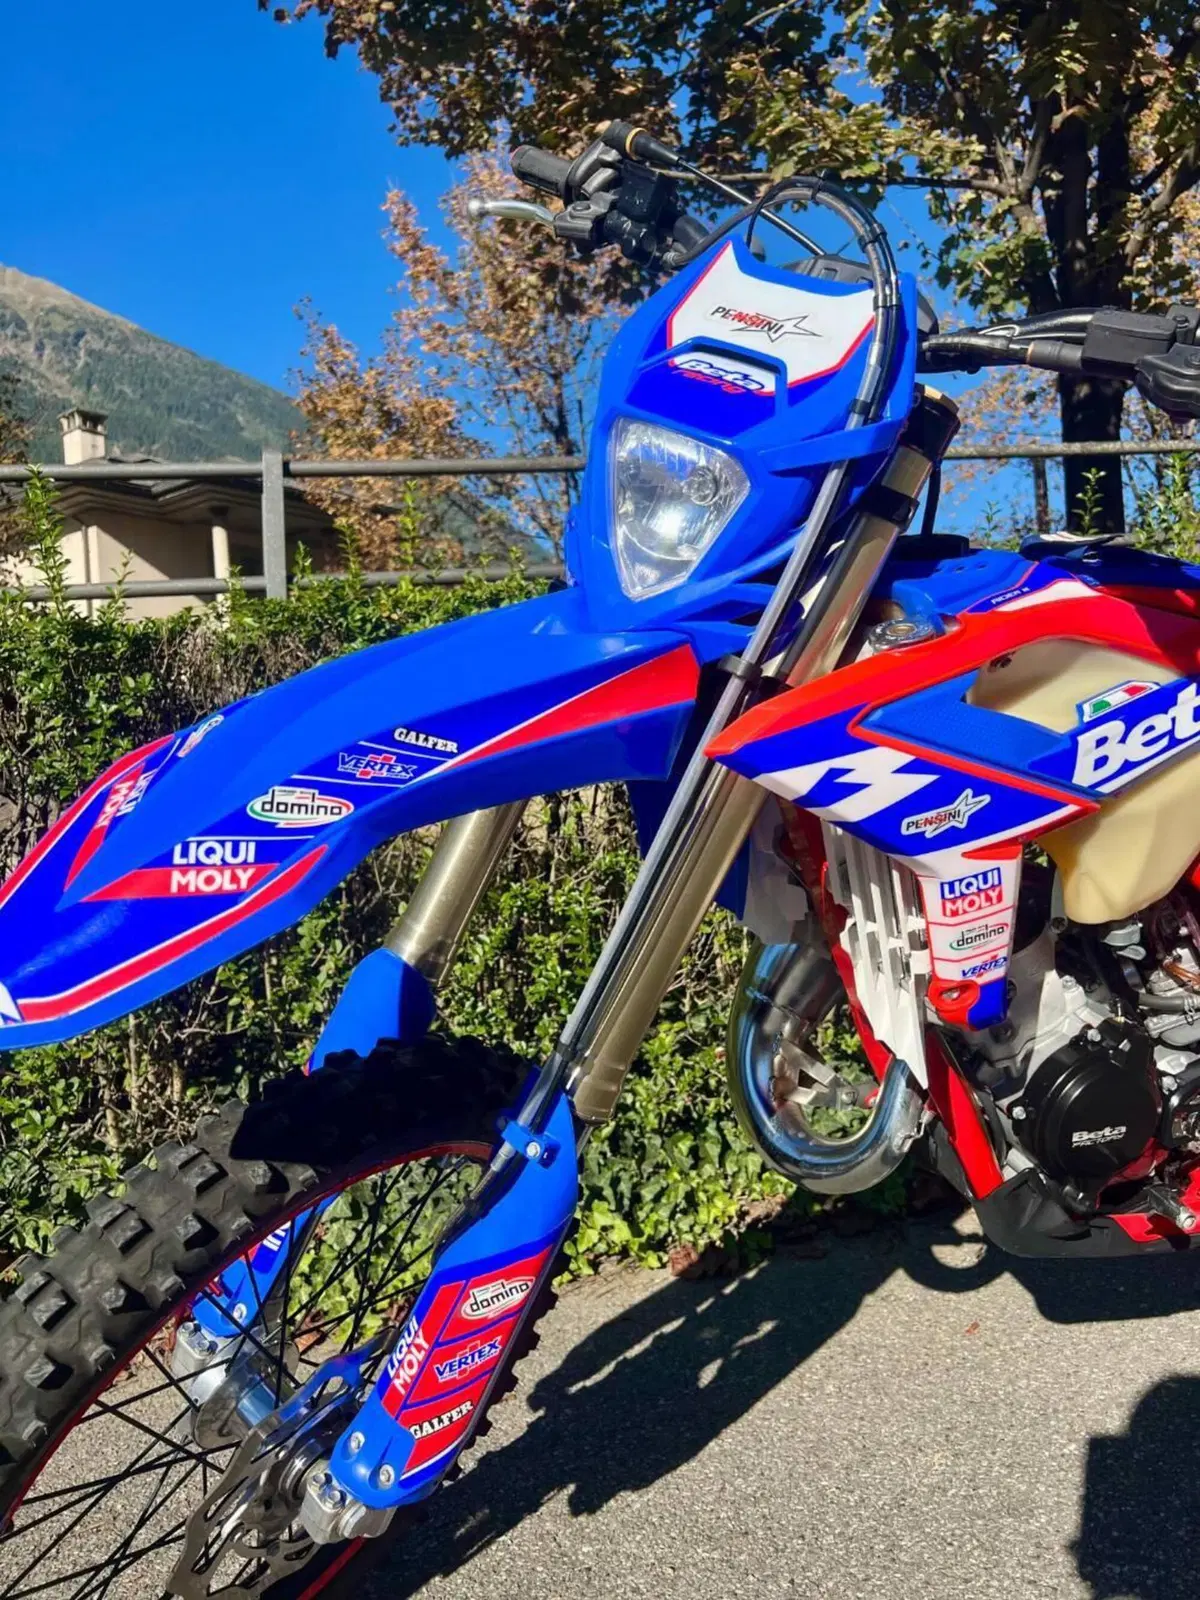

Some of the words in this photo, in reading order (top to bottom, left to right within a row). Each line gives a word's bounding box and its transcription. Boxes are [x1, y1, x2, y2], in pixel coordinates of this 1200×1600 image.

[711, 306, 784, 335] PENSINI
[675, 359, 765, 391] Beta
[393, 727, 459, 753] GALFER
[338, 752, 418, 778] VERTEX
[261, 788, 343, 816] domino
[905, 809, 961, 832] PENSINI
[172, 841, 256, 866] LIQUI
[170, 868, 256, 894] MOLY
[943, 868, 999, 899] LIQUI
[944, 888, 1001, 917] MOLY
[956, 924, 1005, 948] domino
[1072, 1125, 1127, 1142] Beta
[469, 1282, 530, 1313] domino
[387, 1315, 420, 1379] LIQUI
[435, 1338, 502, 1378] VERTEX
[393, 1329, 431, 1396] MOLY
[409, 1401, 474, 1439] GALFER
